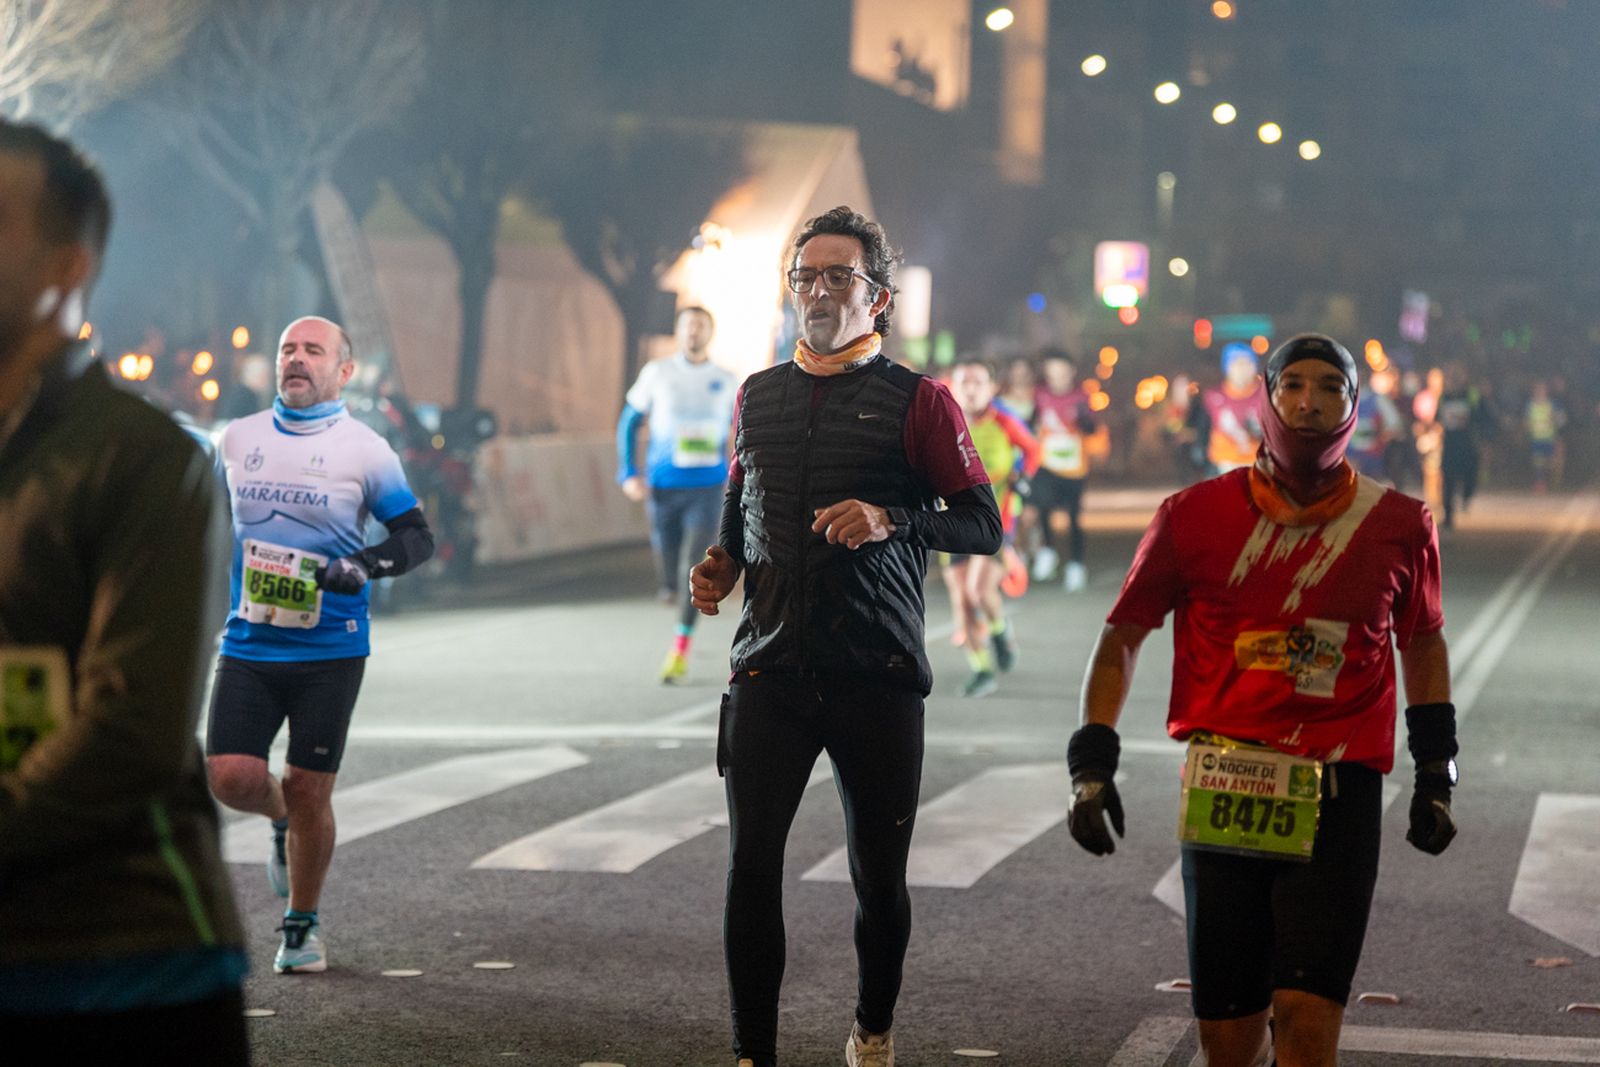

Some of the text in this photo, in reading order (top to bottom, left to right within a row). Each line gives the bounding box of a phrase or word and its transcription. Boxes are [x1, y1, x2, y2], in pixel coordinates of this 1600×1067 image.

[236, 485, 329, 508] MARACENA
[249, 570, 306, 603] 8566
[1217, 761, 1258, 776] NOCHE
[1261, 766, 1277, 779] DE
[1200, 774, 1227, 790] SAN
[1210, 793, 1296, 837] 8475
